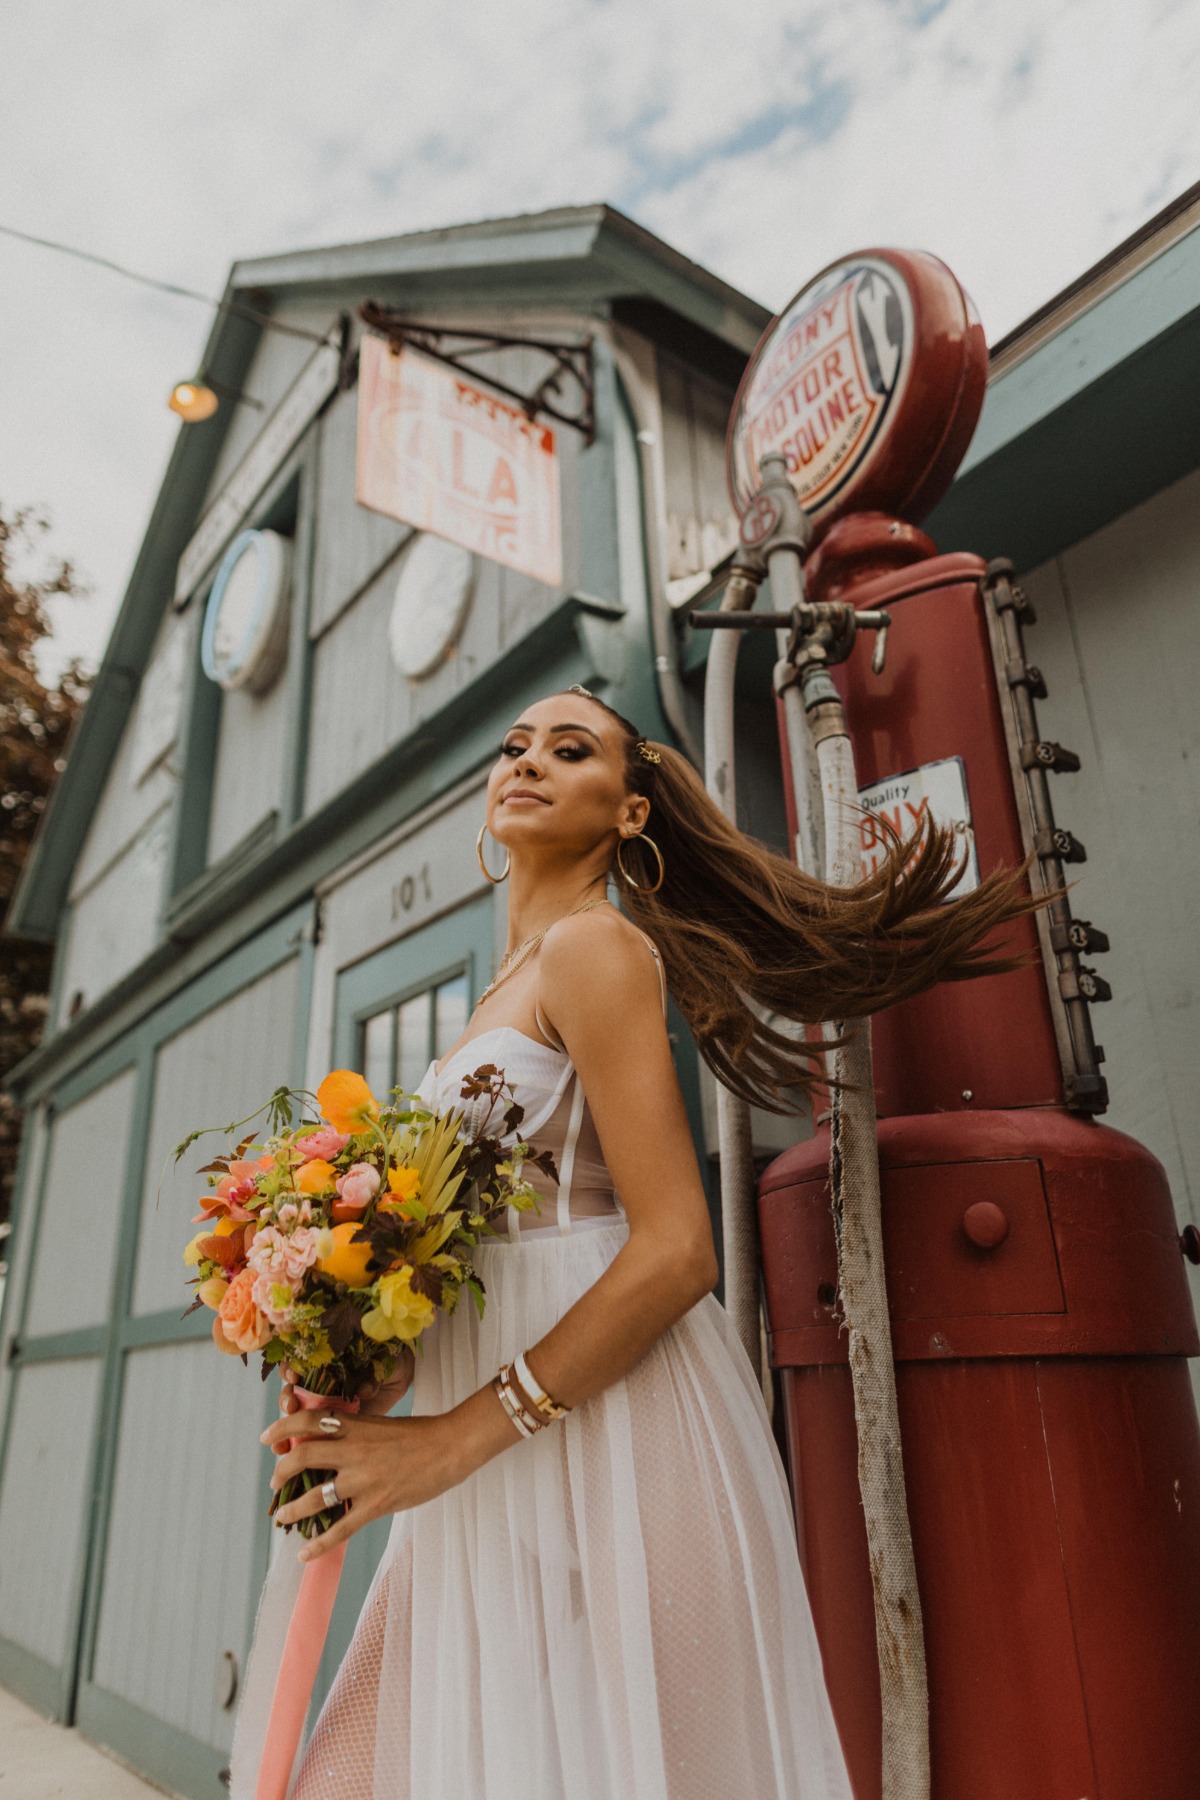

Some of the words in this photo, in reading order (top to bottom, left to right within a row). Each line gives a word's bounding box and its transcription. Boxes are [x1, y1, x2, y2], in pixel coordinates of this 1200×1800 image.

[756, 351, 844, 442] MOTOR
[782, 379, 862, 474] SOLINE
[861, 785, 910, 810] Quality
[1057, 834, 1069, 851] 2
[390, 862, 432, 921] 101
[1073, 927, 1084, 944] 1
